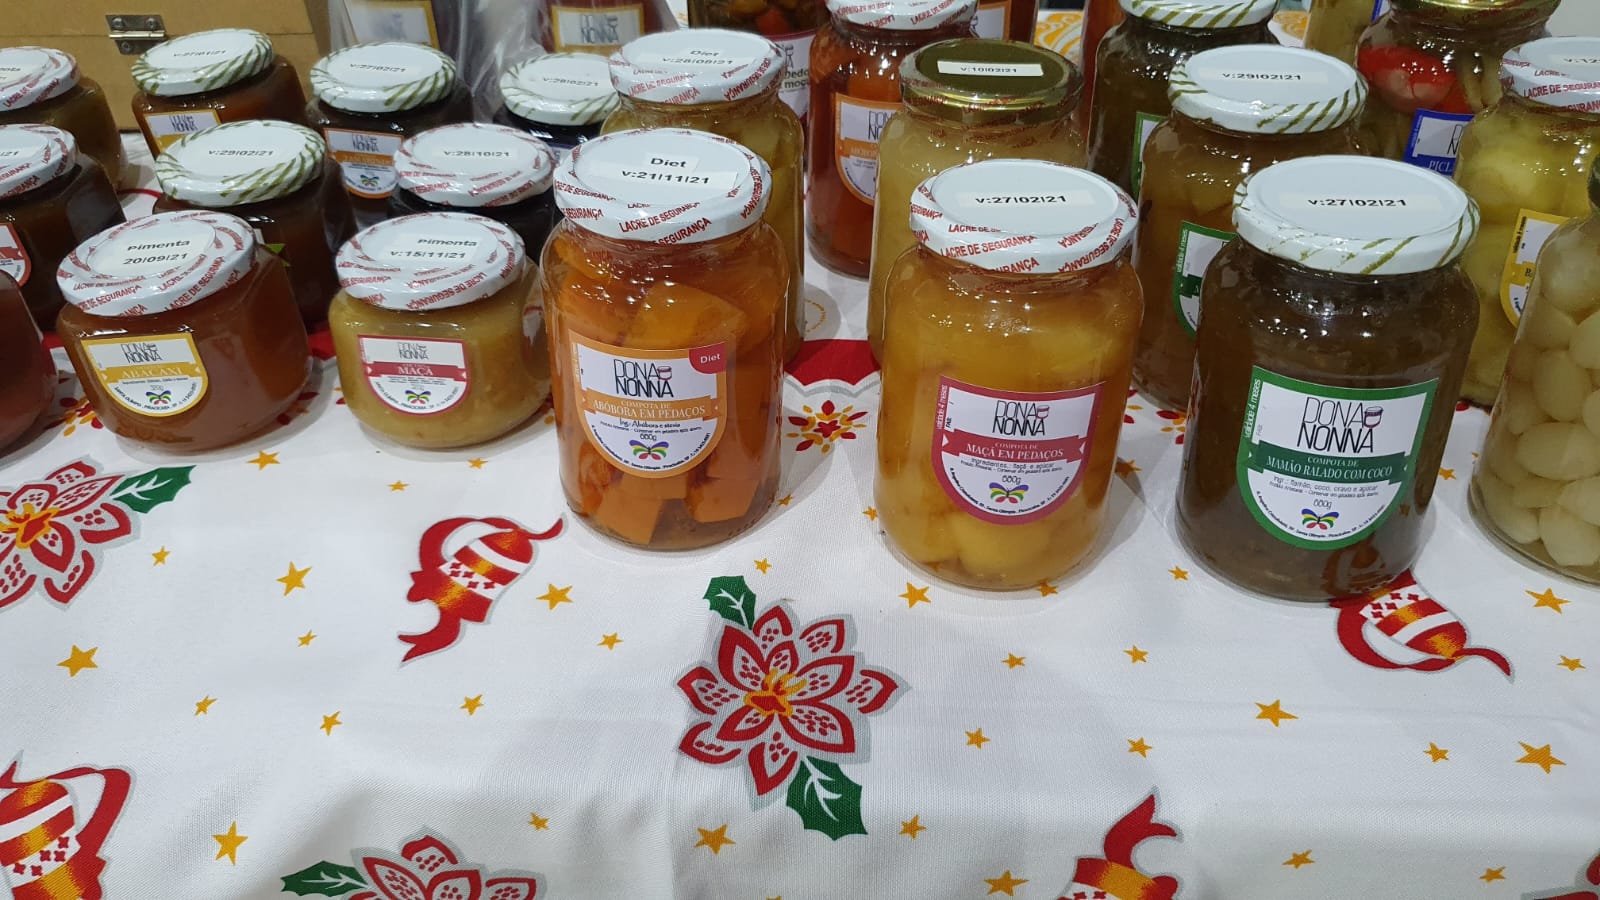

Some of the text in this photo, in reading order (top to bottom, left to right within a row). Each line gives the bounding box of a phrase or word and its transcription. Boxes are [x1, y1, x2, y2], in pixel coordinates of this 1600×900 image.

[1523, 85, 1549, 98] LACRE
[1549, 84, 1562, 94] DE
[650, 158, 687, 168] Diet
[618, 201, 701, 233] LACRE DE SEGURANÇA
[948, 224, 978, 233] LACRE
[127, 240, 190, 251] Pimenta
[940, 235, 1038, 257] LACRE DE SEGURANÇA
[191, 285, 202, 297] DE
[700, 353, 721, 364] Diet
[613, 359, 660, 380] DONA
[615, 377, 675, 398] NONNA
[593, 399, 706, 419] ABÓBORA EM PEDAÇOS
[995, 399, 1037, 419] DONA
[1302, 396, 1365, 428] DONA
[992, 416, 1045, 436] NONNA
[1297, 422, 1374, 453] NONNA
[997, 450, 1016, 459] EM
[1017, 448, 1065, 461] PEDAÇOS
[1307, 456, 1346, 467] COMPOTA
[1303, 465, 1343, 479] RALADO
[1343, 467, 1368, 479] COM
[1367, 466, 1393, 479] COCO
